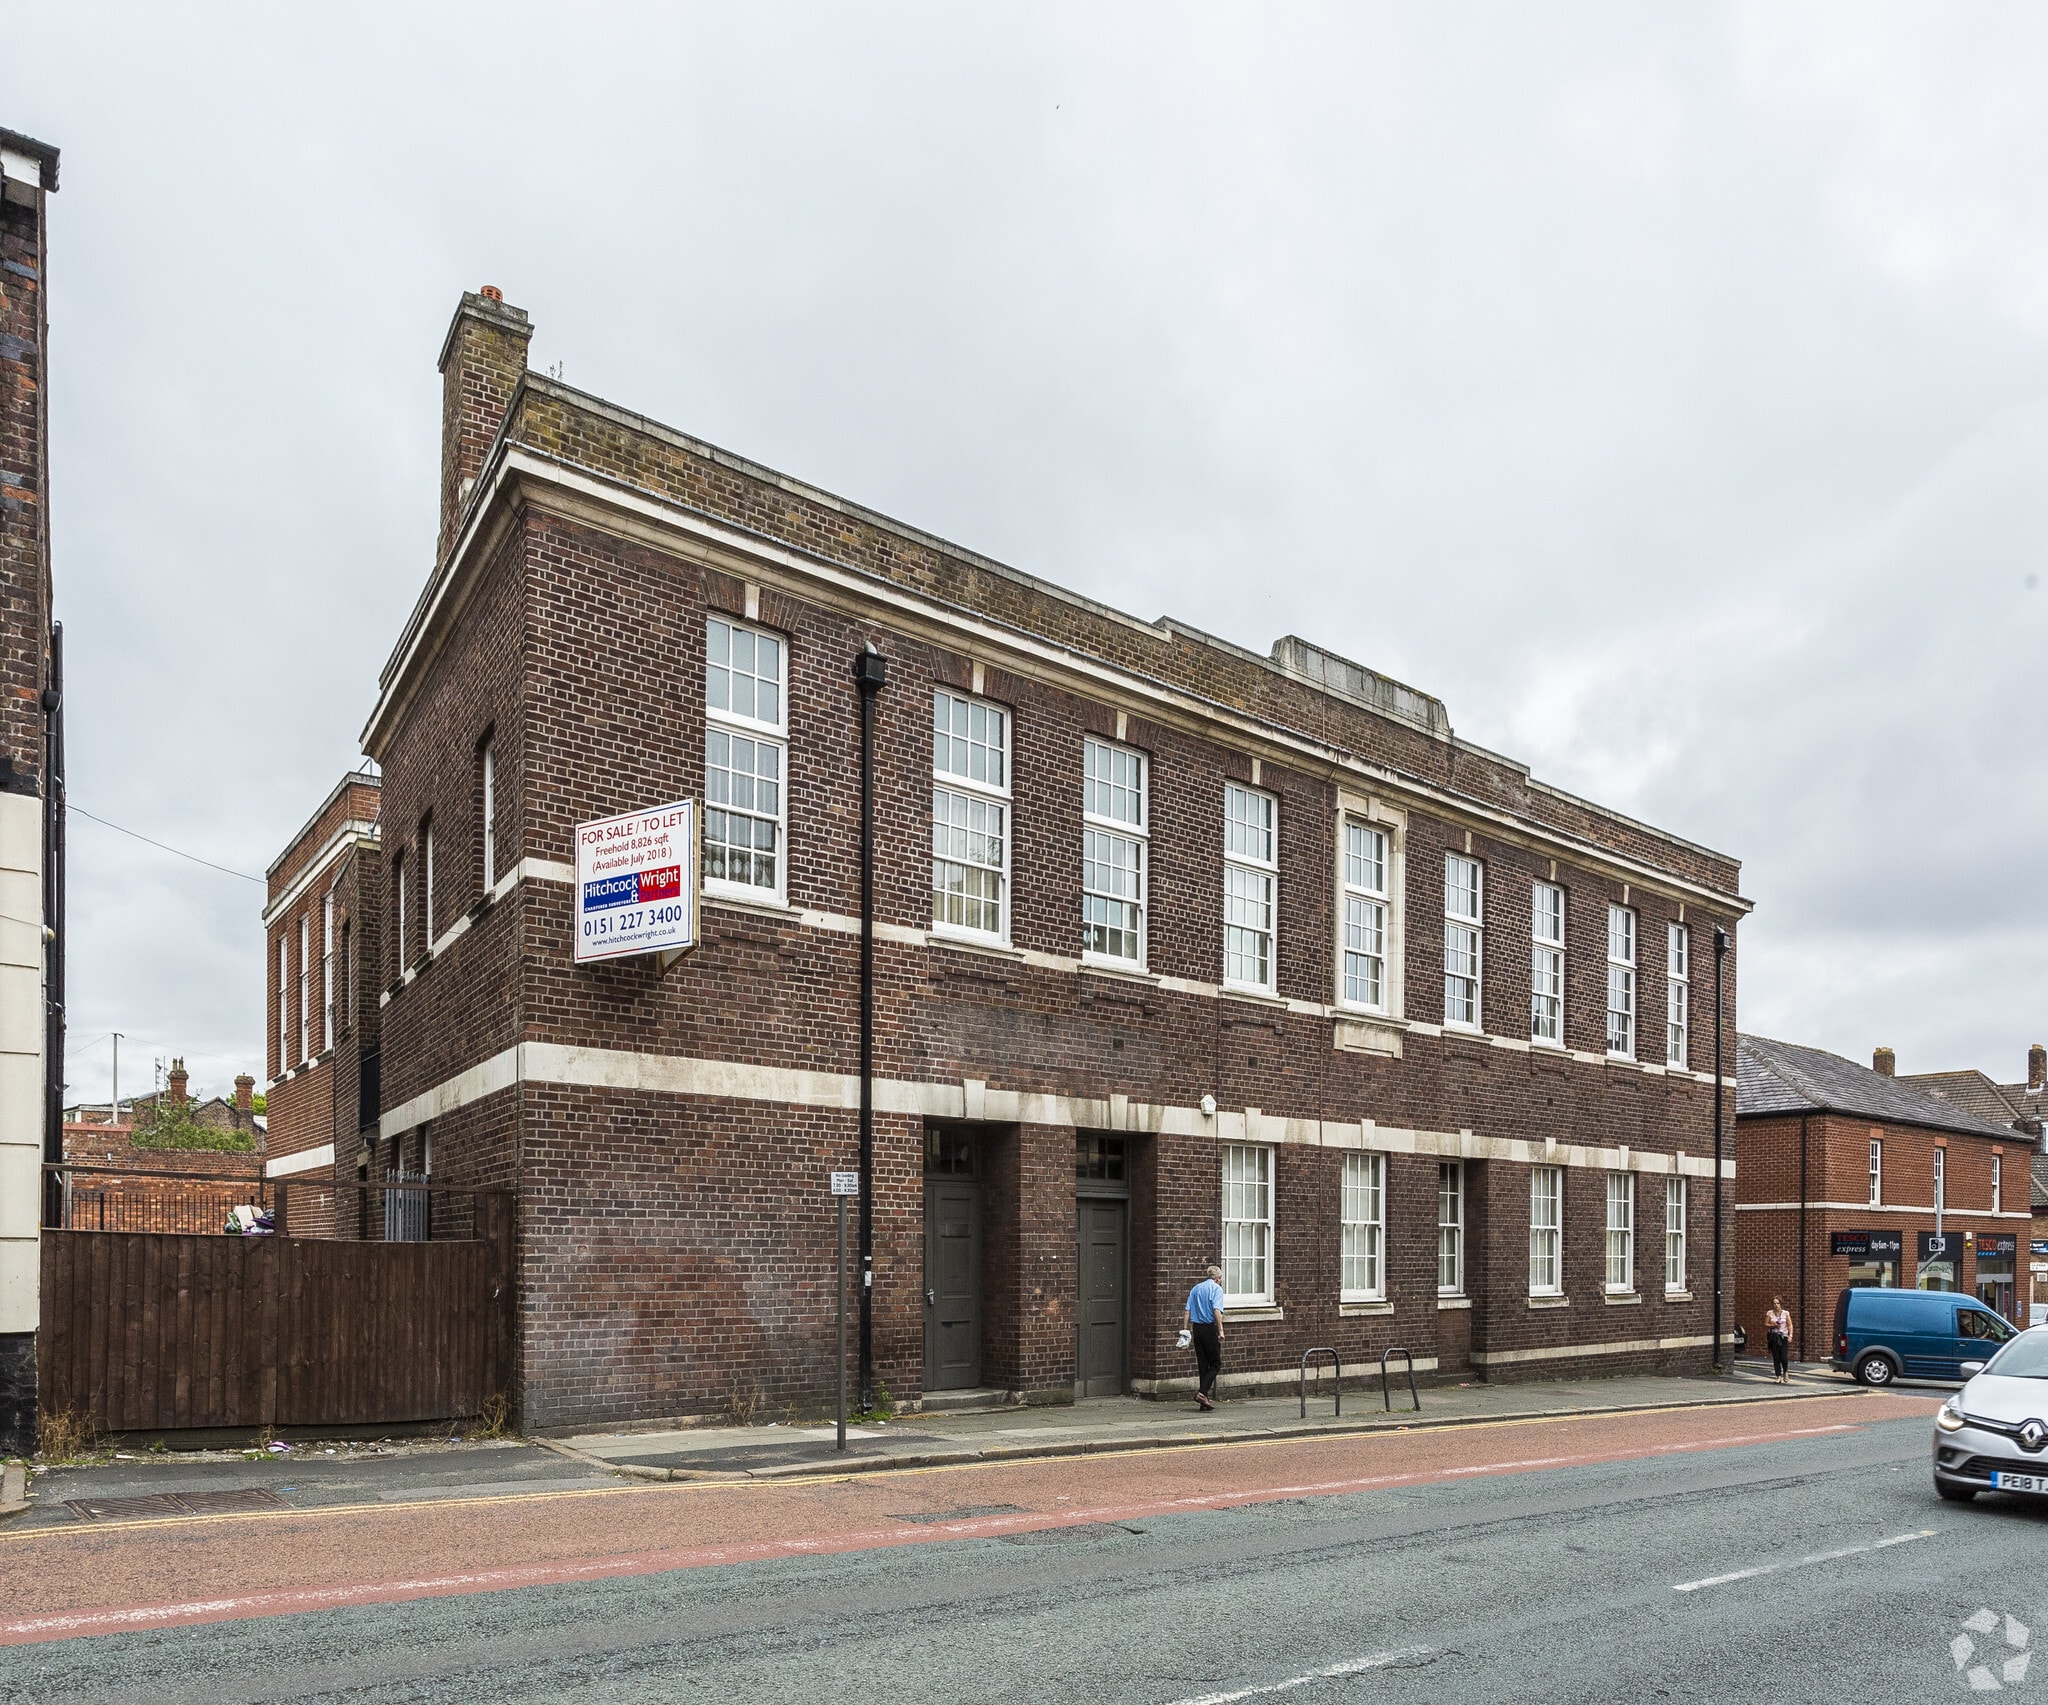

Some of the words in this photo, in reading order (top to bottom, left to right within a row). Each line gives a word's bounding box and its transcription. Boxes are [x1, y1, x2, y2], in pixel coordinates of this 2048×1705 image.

[581, 829, 604, 846] FOR
[606, 822, 634, 840] SALE
[636, 822, 639, 834] /
[642, 817, 660, 832] TO
[663, 811, 685, 828] LET
[595, 841, 629, 857] Freehold
[630, 835, 653, 850] 8,826
[654, 832, 669, 846] sqft
[592, 855, 629, 875] (Available
[630, 852, 645, 867] July
[647, 848, 667, 861] 2018
[584, 875, 638, 899] Hitchcock
[640, 868, 679, 888] Wright
[630, 889, 640, 903] &
[640, 886, 679, 902] Partners
[584, 903, 608, 912] CHARTERED
[608, 899, 631, 908] SURVEYORS
[584, 916, 613, 937] 0151
[619, 910, 644, 931] 227
[648, 905, 682, 926] 3400
[592, 926, 676, 947] www.hitchcockwright.co.uk
[1836, 1246, 1866, 1254] express
[1977, 1239, 1997, 1251] TESCO
[1997, 1240, 2015, 1254] express
[2002, 1475, 2032, 1489] PE18
[2036, 1479, 2048, 1491] T
